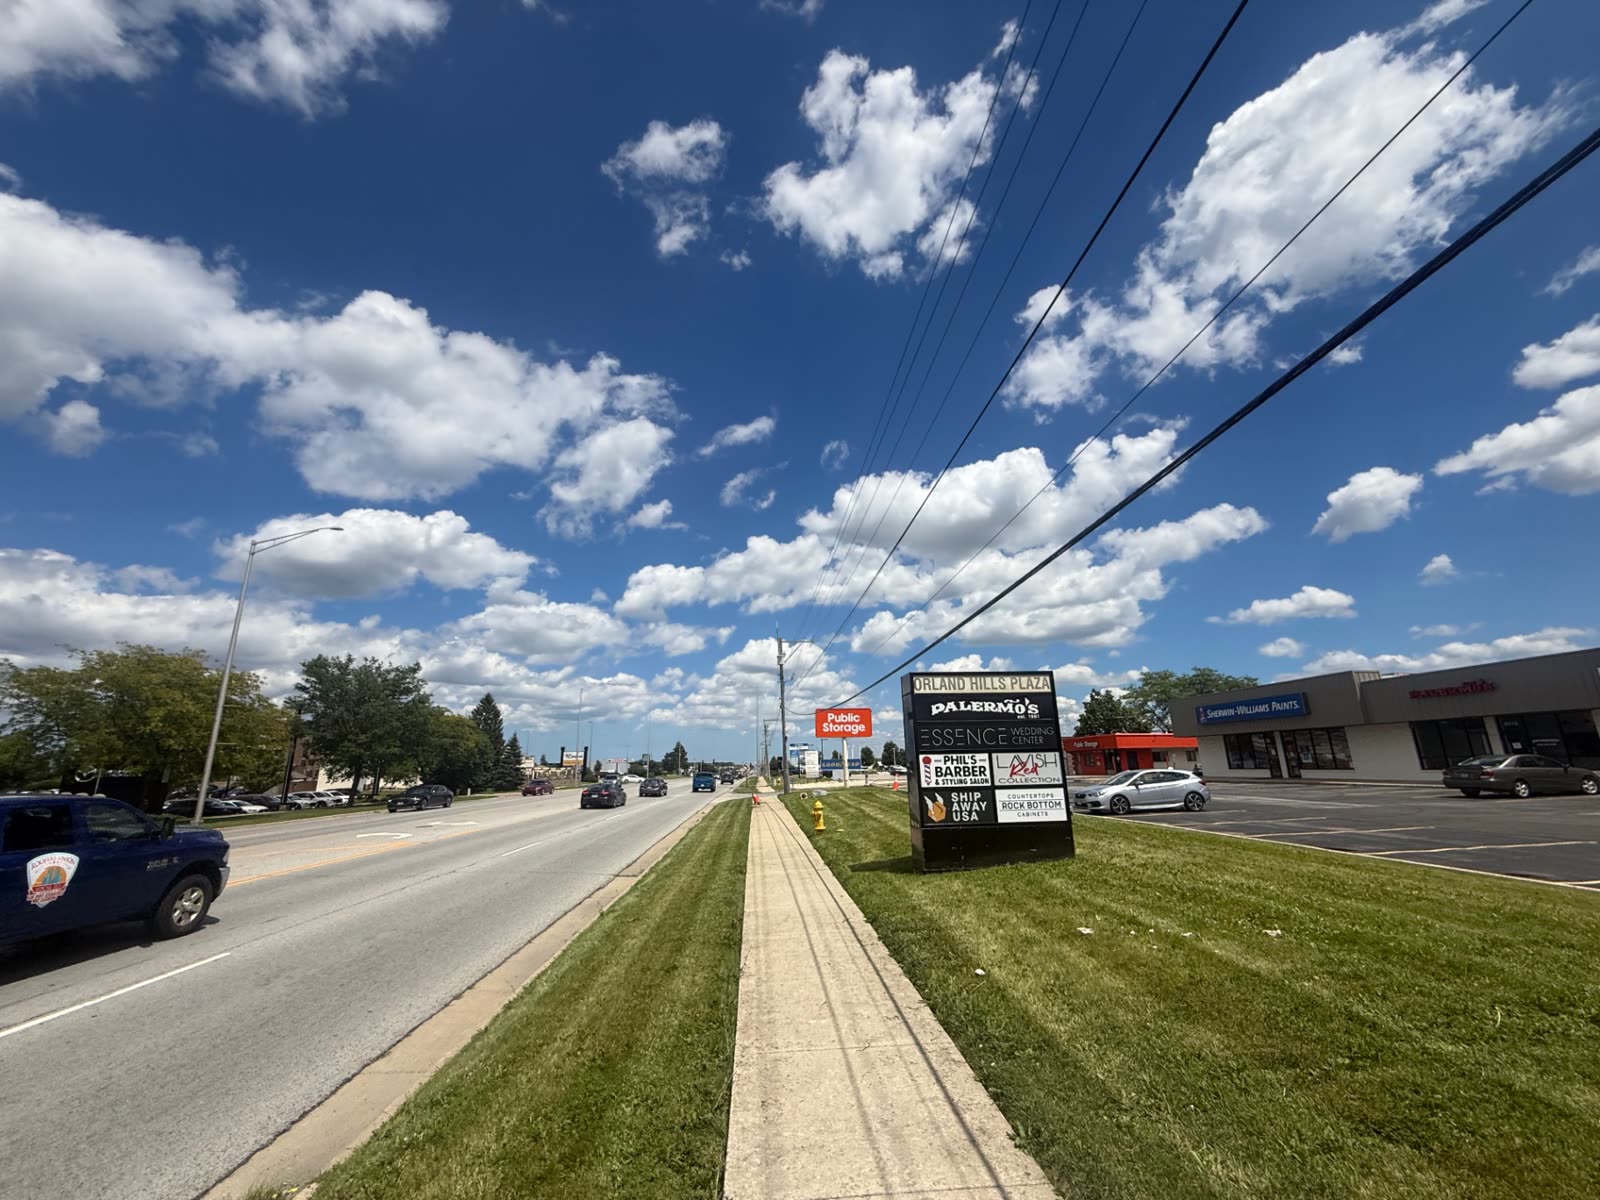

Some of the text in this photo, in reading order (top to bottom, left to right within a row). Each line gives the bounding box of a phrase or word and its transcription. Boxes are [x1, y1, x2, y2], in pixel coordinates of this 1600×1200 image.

[914, 675, 1051, 692] ORLAND HILLS PLAZA
[931, 697, 1039, 715] PALERMO'S
[1207, 703, 1270, 719] SHERWIN-WILLIAMS
[827, 713, 860, 722] Public
[822, 722, 866, 734] Storage
[1010, 726, 1054, 736] WEDDING
[920, 727, 1008, 746] ESSENCE
[1012, 736, 1044, 745] CENTER
[944, 755, 977, 765] PHIL'S
[996, 753, 1058, 769] LAVISH
[935, 766, 987, 778] BARBER
[1010, 761, 1039, 777] Red
[941, 778, 968, 786] STYLING
[970, 777, 990, 785] SALON
[951, 792, 981, 802] SHIP
[952, 801, 987, 811] AWAY
[1002, 801, 1062, 810] ROCK BOTTOM
[953, 811, 979, 822] USA
